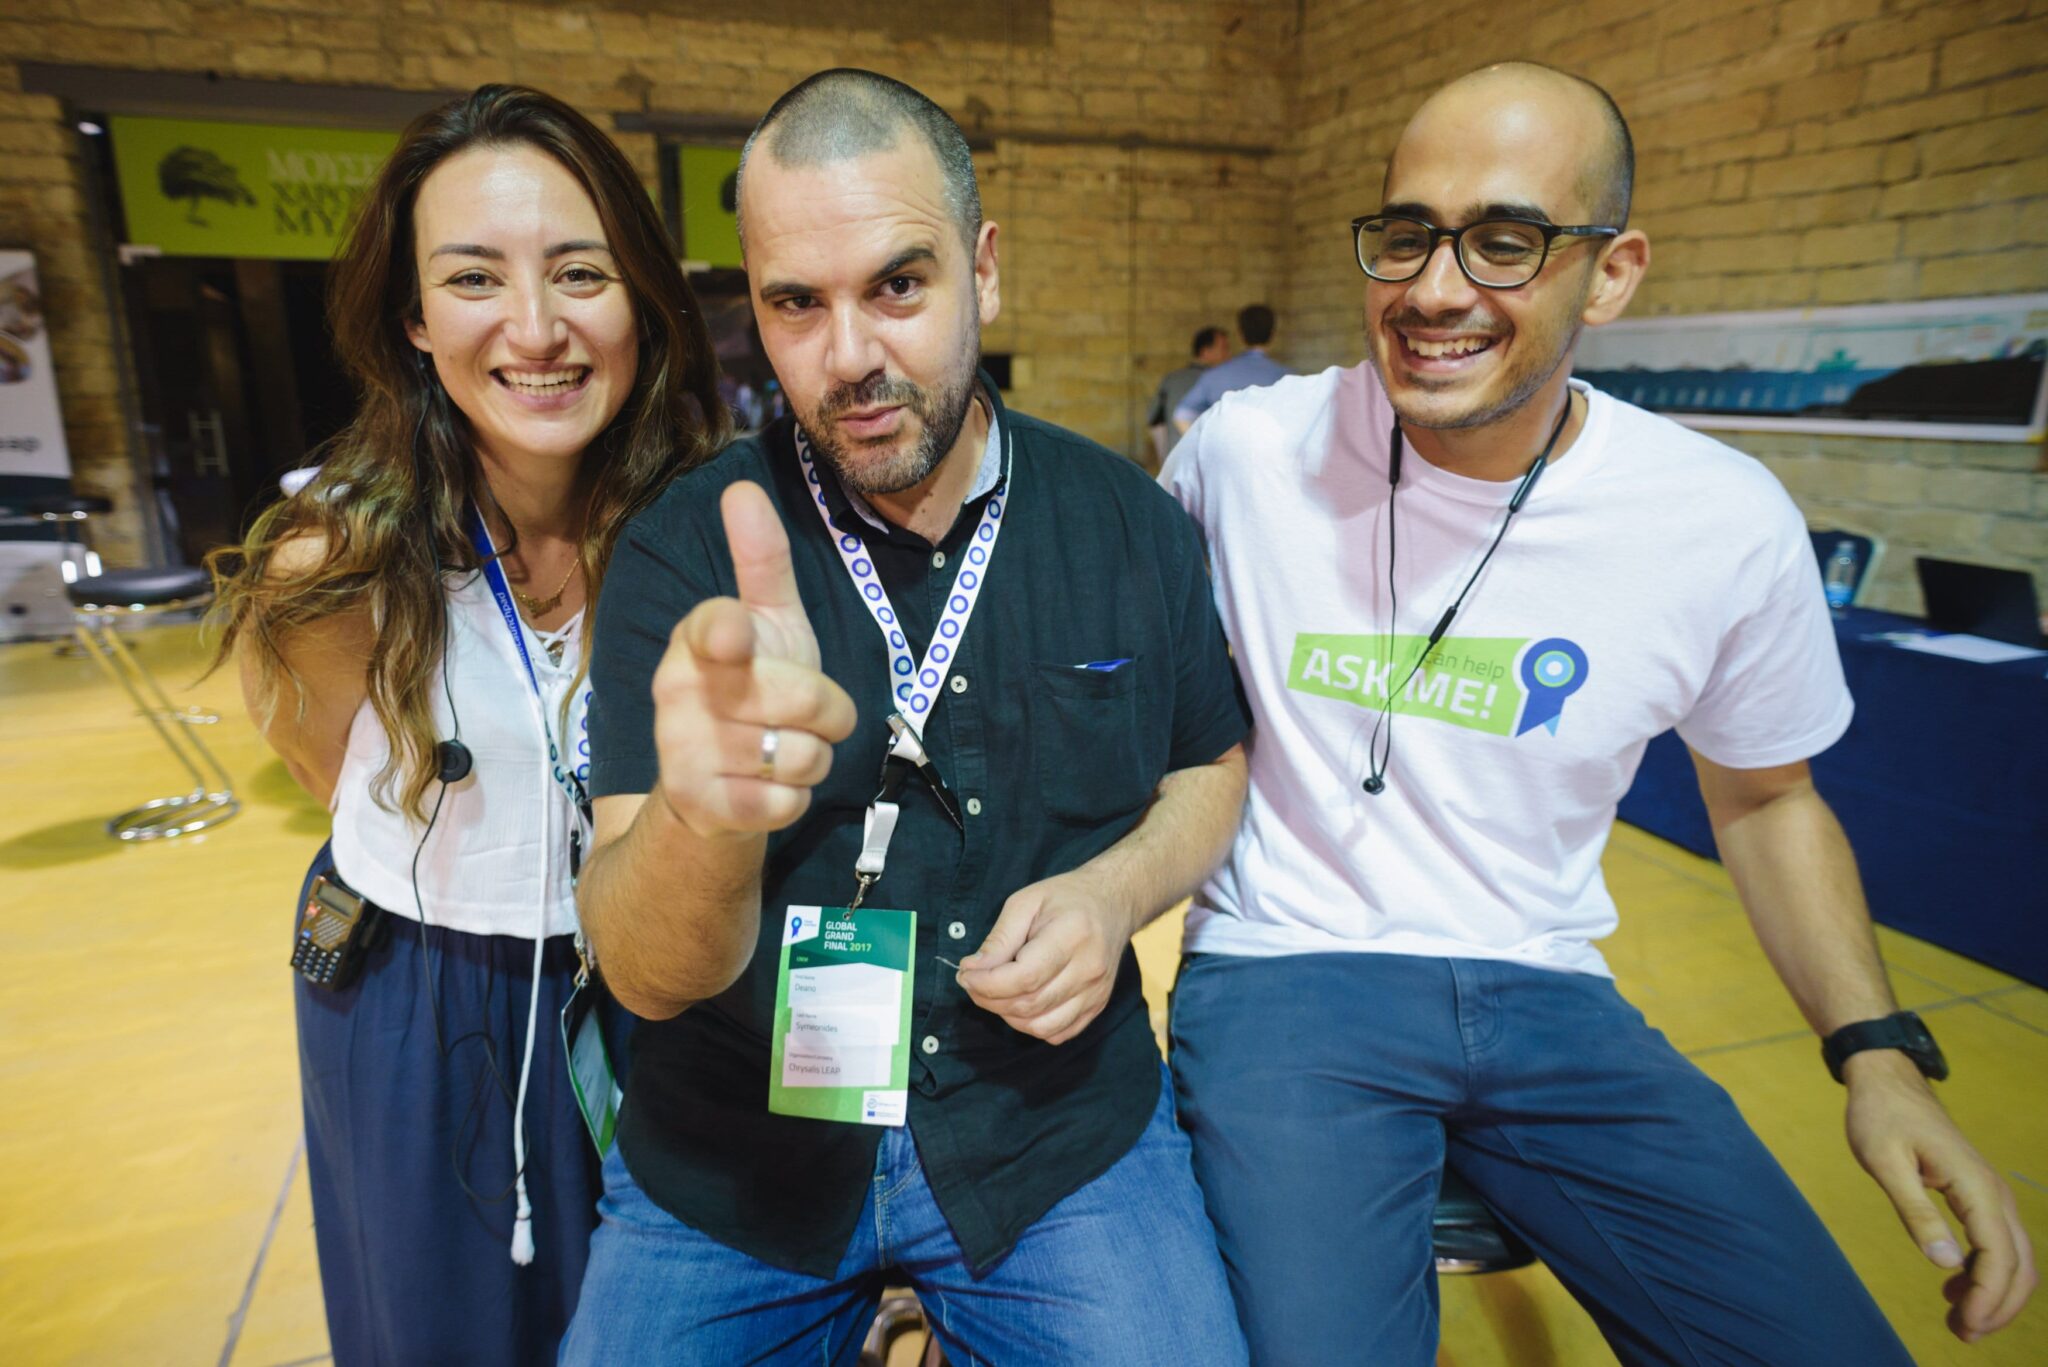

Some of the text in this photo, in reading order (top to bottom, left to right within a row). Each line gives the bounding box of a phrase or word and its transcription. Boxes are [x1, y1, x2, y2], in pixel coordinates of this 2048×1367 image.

[1462, 655, 1505, 682] help
[1302, 647, 1499, 720] ASK ME!
[825, 920, 858, 932] GLOBAL
[824, 931, 855, 941] GRAND
[823, 941, 872, 952] FINAL 2017
[788, 1062, 841, 1075] Chrysalis LEAP
